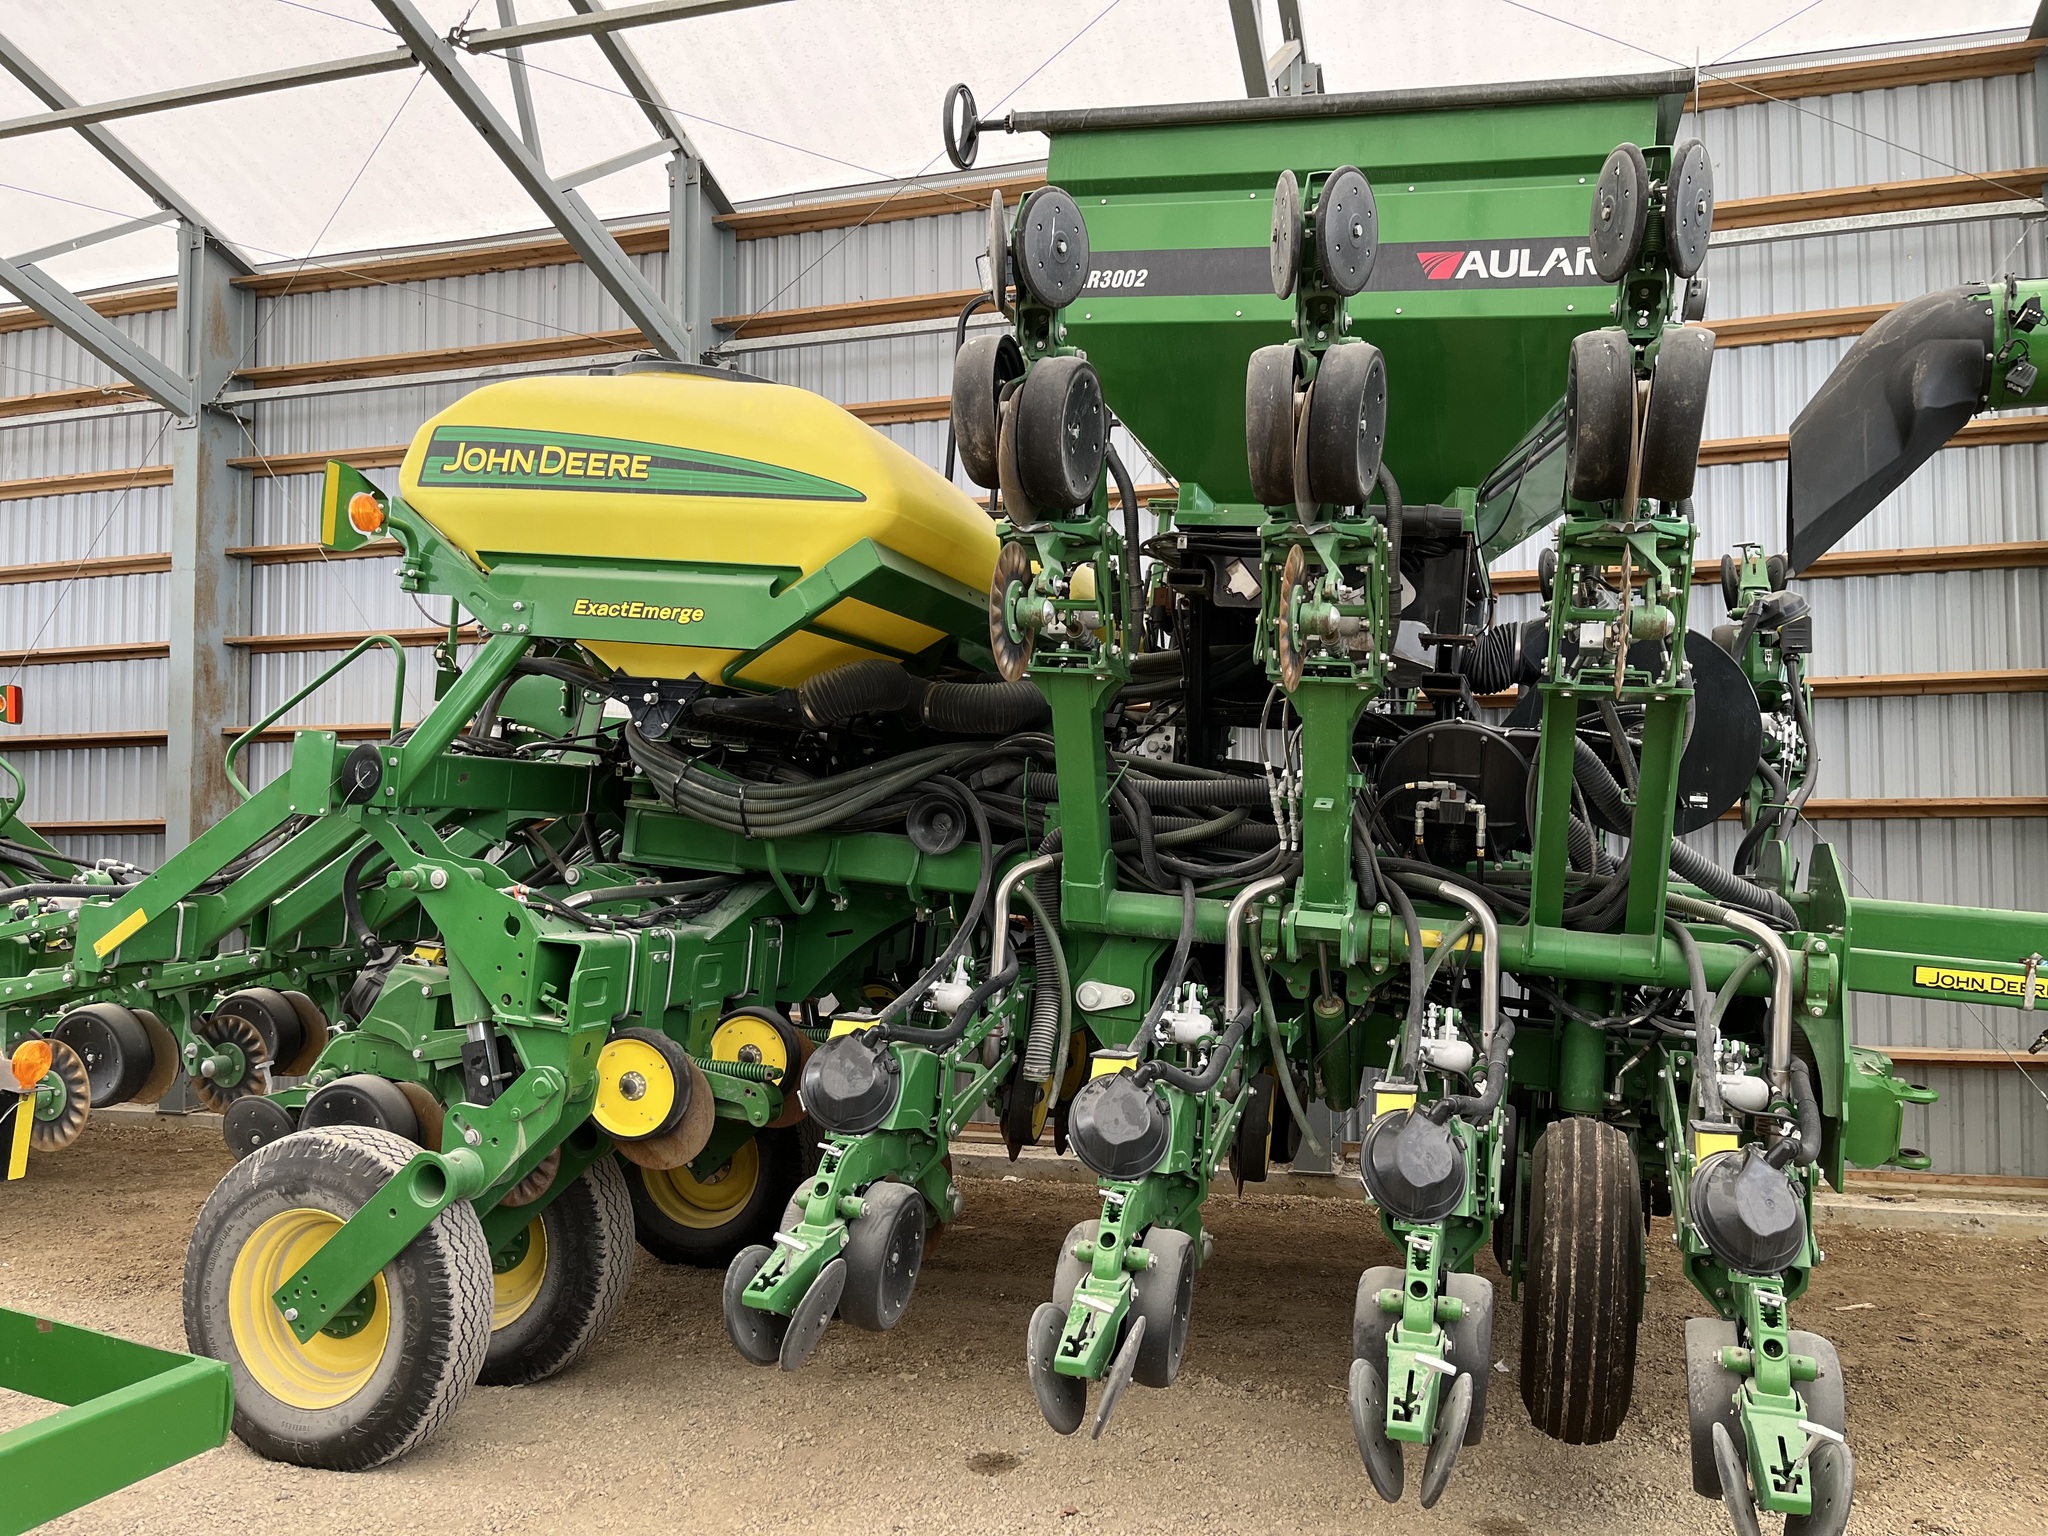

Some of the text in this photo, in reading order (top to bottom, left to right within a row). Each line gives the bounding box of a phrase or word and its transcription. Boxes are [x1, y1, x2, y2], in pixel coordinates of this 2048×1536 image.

[1082, 268, 1149, 289] R3002
[441, 441, 653, 480] JOHN DEERE
[572, 598, 705, 625] ExactEmerge
[1928, 971, 2048, 997] JOHN DER
